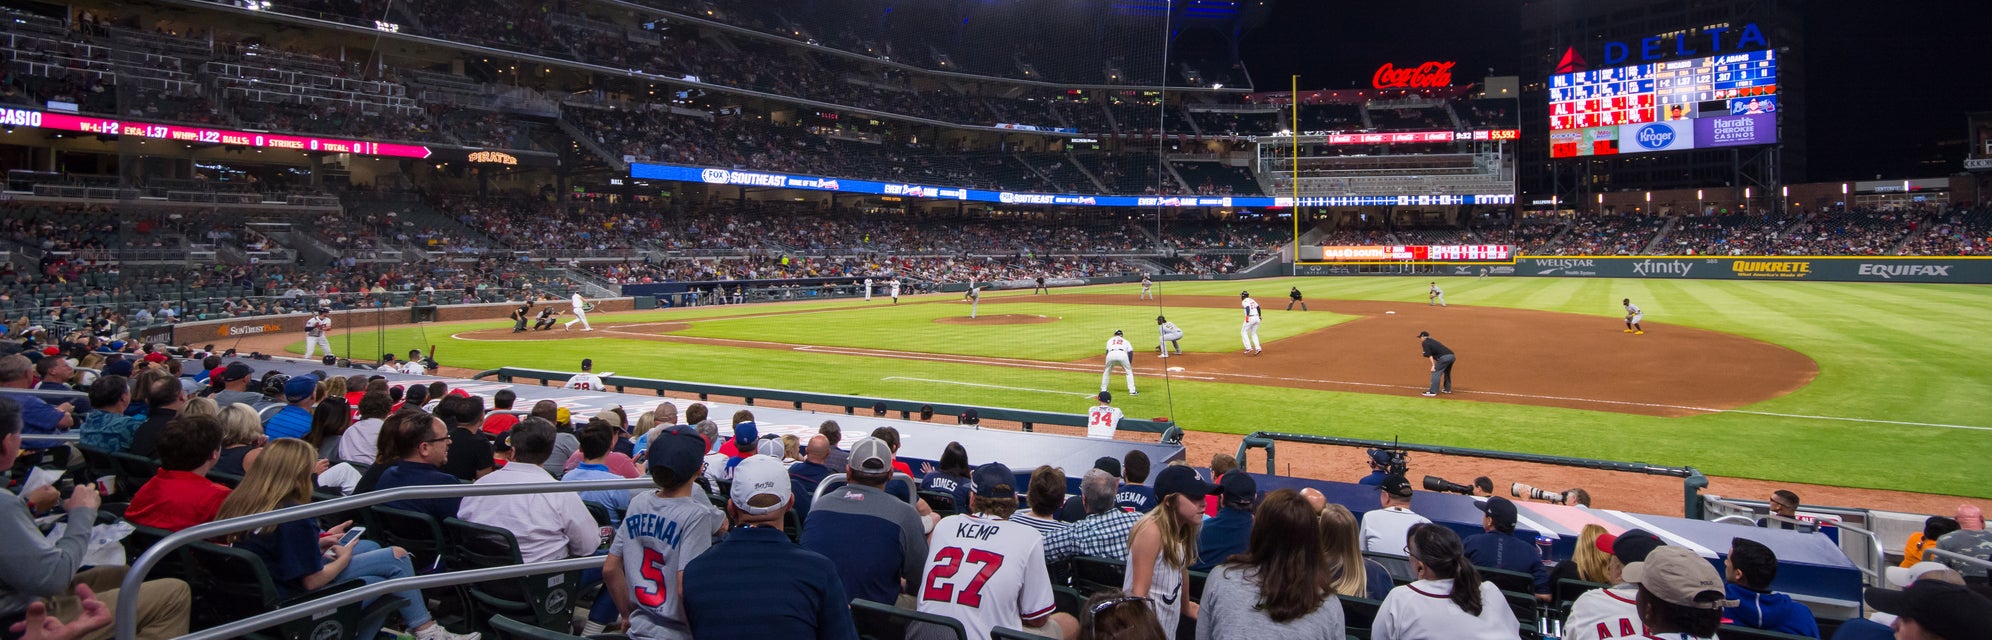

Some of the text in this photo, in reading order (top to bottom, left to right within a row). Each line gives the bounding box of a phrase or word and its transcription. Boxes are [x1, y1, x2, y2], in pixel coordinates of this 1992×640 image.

[1604, 22, 1767, 65] DELTA
[1372, 61, 1456, 89] Coca-Cola
[1554, 75, 1568, 87] NL
[1555, 104, 1568, 115] AL
[147, 125, 168, 138] 1.37
[199, 130, 219, 143] 1.22
[1491, 130, 1515, 140] $5,592
[1639, 128, 1673, 147] Kroger
[1714, 132, 1754, 140] CASINOS
[708, 170, 787, 187] FOX SOUTHEAST
[884, 184, 902, 194] EVERY
[1013, 193, 1054, 204] SOUTHEAST
[1325, 249, 1345, 258] GAS
[1353, 249, 1382, 258] SOUTH
[1536, 259, 1594, 268] WELLSTAR
[1633, 258, 1693, 276] xfinity
[1732, 260, 1810, 273] QUIKRETE
[1858, 263, 1949, 278] EQUIFAX
[1091, 411, 1112, 427] 34
[931, 477, 957, 491] JONES
[1114, 491, 1147, 506] REEMAN
[956, 522, 1000, 541] KEMP
[635, 546, 666, 608] 5
[923, 546, 1004, 608] 27
